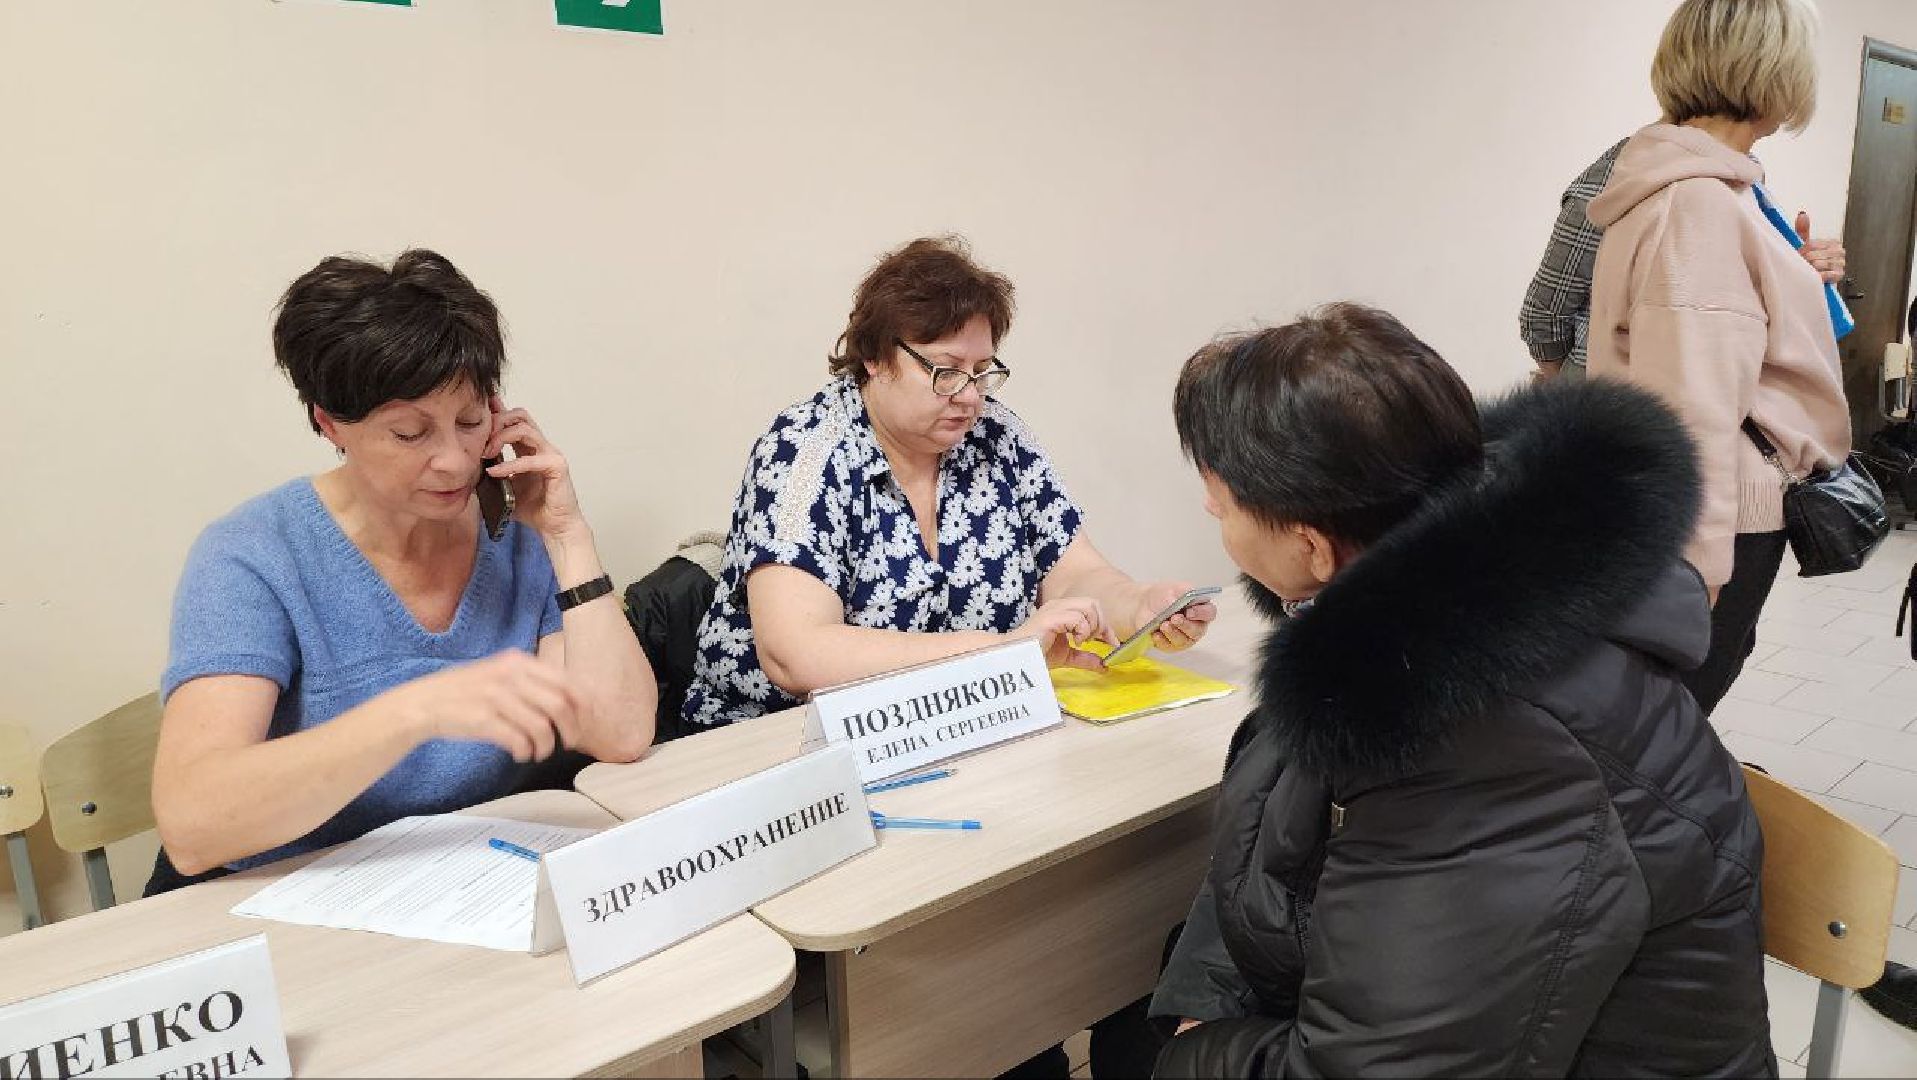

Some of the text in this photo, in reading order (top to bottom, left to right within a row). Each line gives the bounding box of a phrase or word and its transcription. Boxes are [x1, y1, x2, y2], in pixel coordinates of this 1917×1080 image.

[841, 668, 1035, 739] ПОЗДНЯКОВА
[867, 704, 1031, 765] ЕЛЕНА СЕРГЕЕВНА
[583, 793, 850, 922] ЗДРАВООХРАНЕНИЕ
